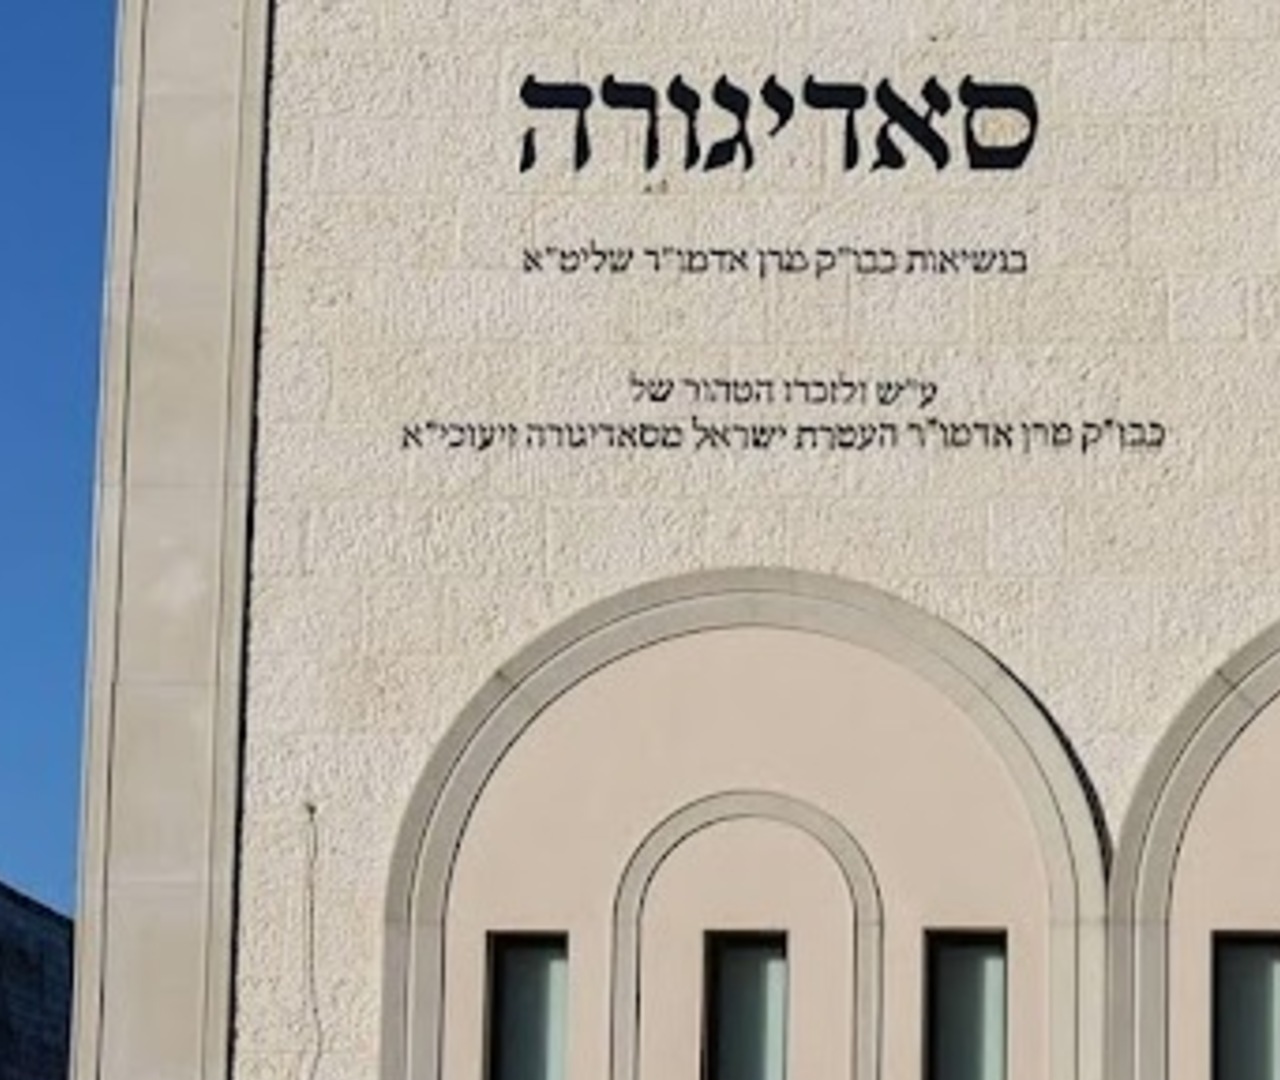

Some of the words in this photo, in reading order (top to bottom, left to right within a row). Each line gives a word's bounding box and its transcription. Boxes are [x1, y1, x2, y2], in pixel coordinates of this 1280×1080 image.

[518, 73, 1039, 173] סאדיגורה
[522, 239, 635, 275] שליט"א
[643, 246, 750, 274] אדמו"ר
[756, 247, 810, 281] מרן
[904, 248, 1028, 275] בנשיאות
[628, 371, 675, 403] של
[681, 377, 775, 405] הטהור
[782, 371, 868, 405] ולזכרו
[526, 422, 684, 450] מסאדיגורה
[690, 414, 788, 451] ישראל
[906, 416, 1015, 450] אדמו"ר
[1020, 421, 1073, 454] מרן
[1080, 417, 1166, 456] כבו"ק
